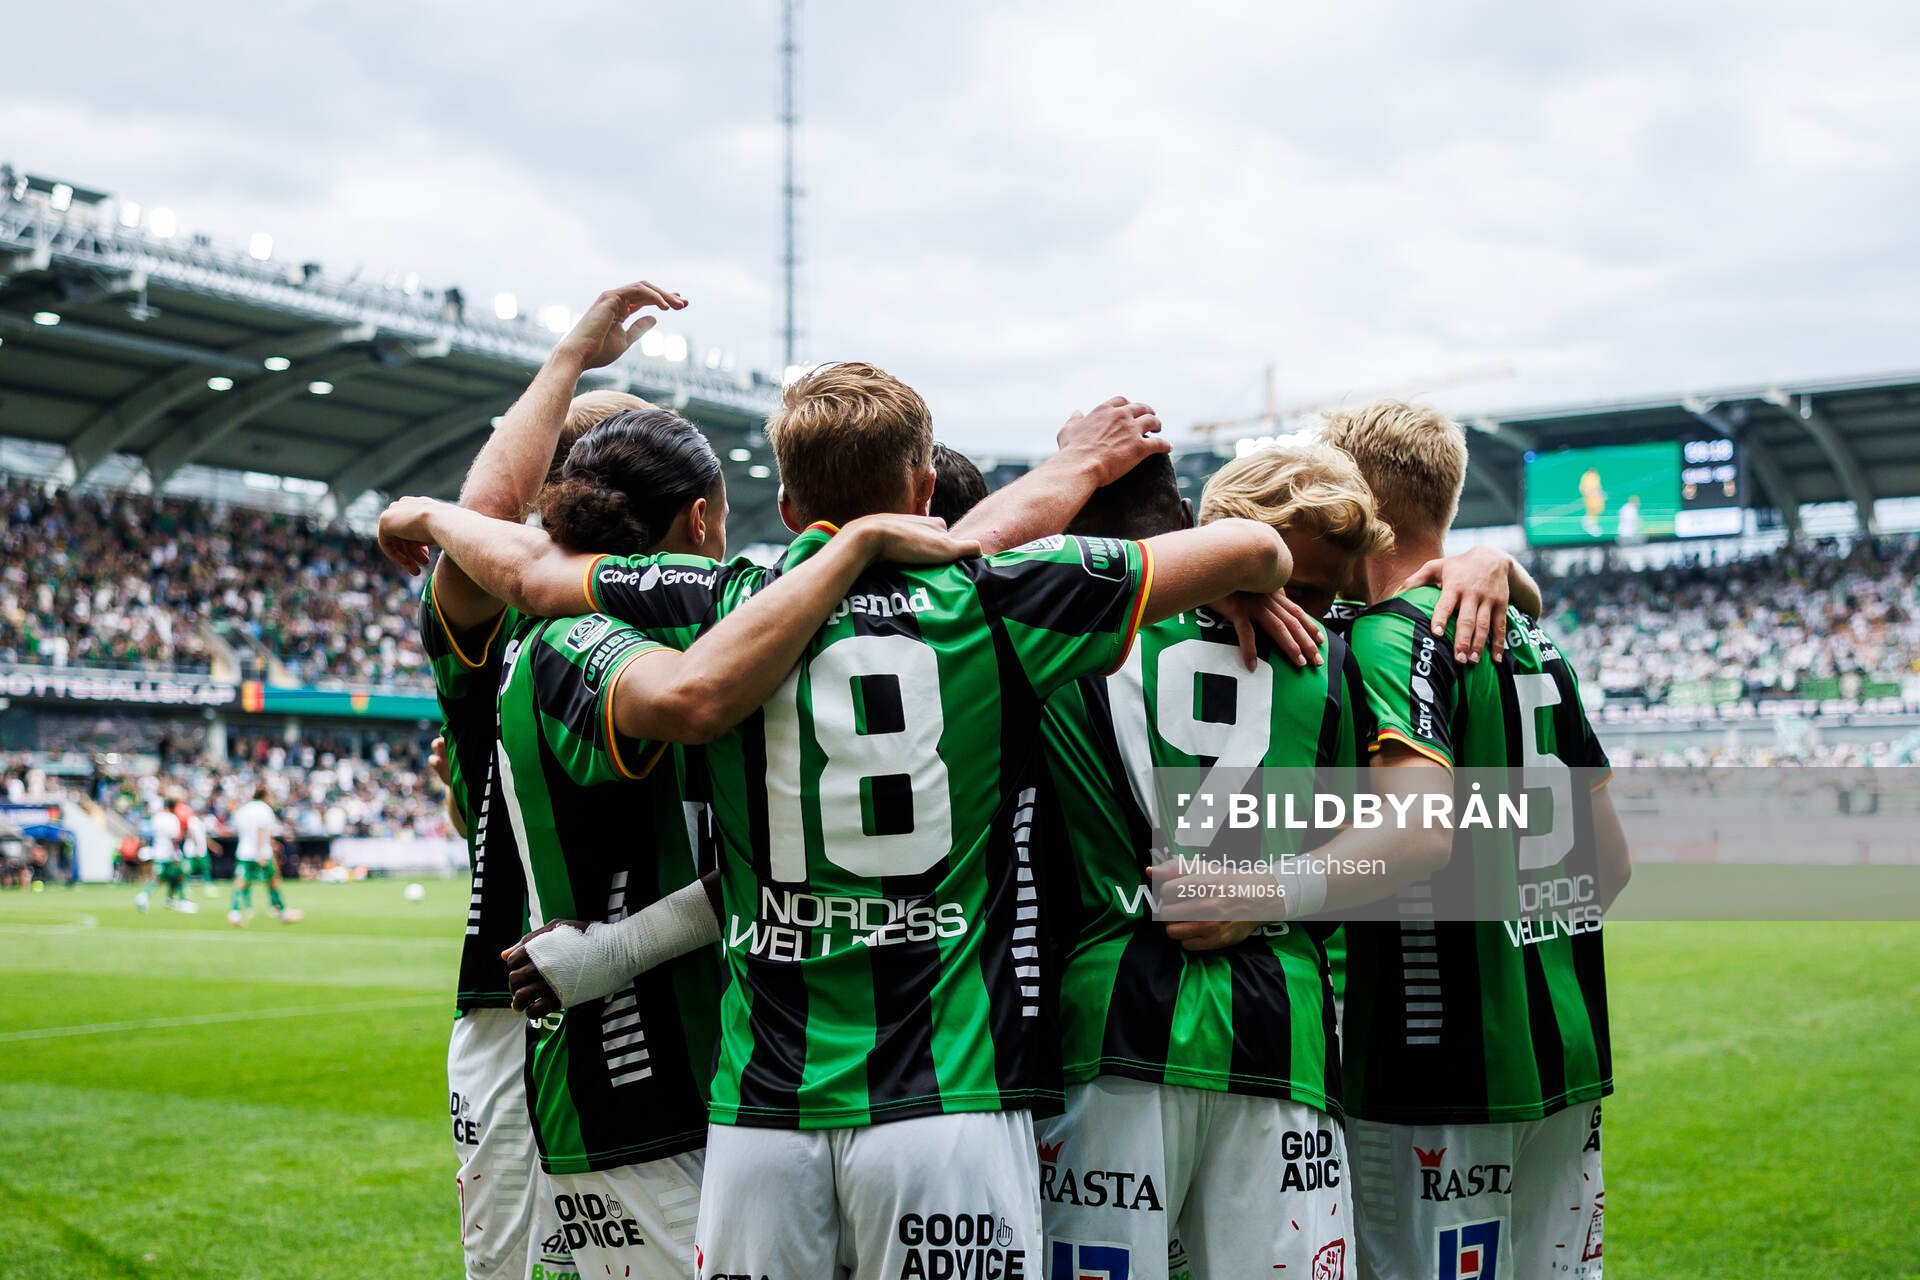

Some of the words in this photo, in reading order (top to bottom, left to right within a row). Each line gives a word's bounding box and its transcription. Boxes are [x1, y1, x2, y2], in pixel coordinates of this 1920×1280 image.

[763, 634, 953, 883] 18
[1107, 633, 1273, 847] 19
[1513, 673, 1574, 871] 5
[1039, 1164, 1164, 1211] RASTA
[1420, 1164, 1513, 1202] RAST
[899, 1213, 995, 1247] GOOD
[900, 1248, 1026, 1280] ADVICE
